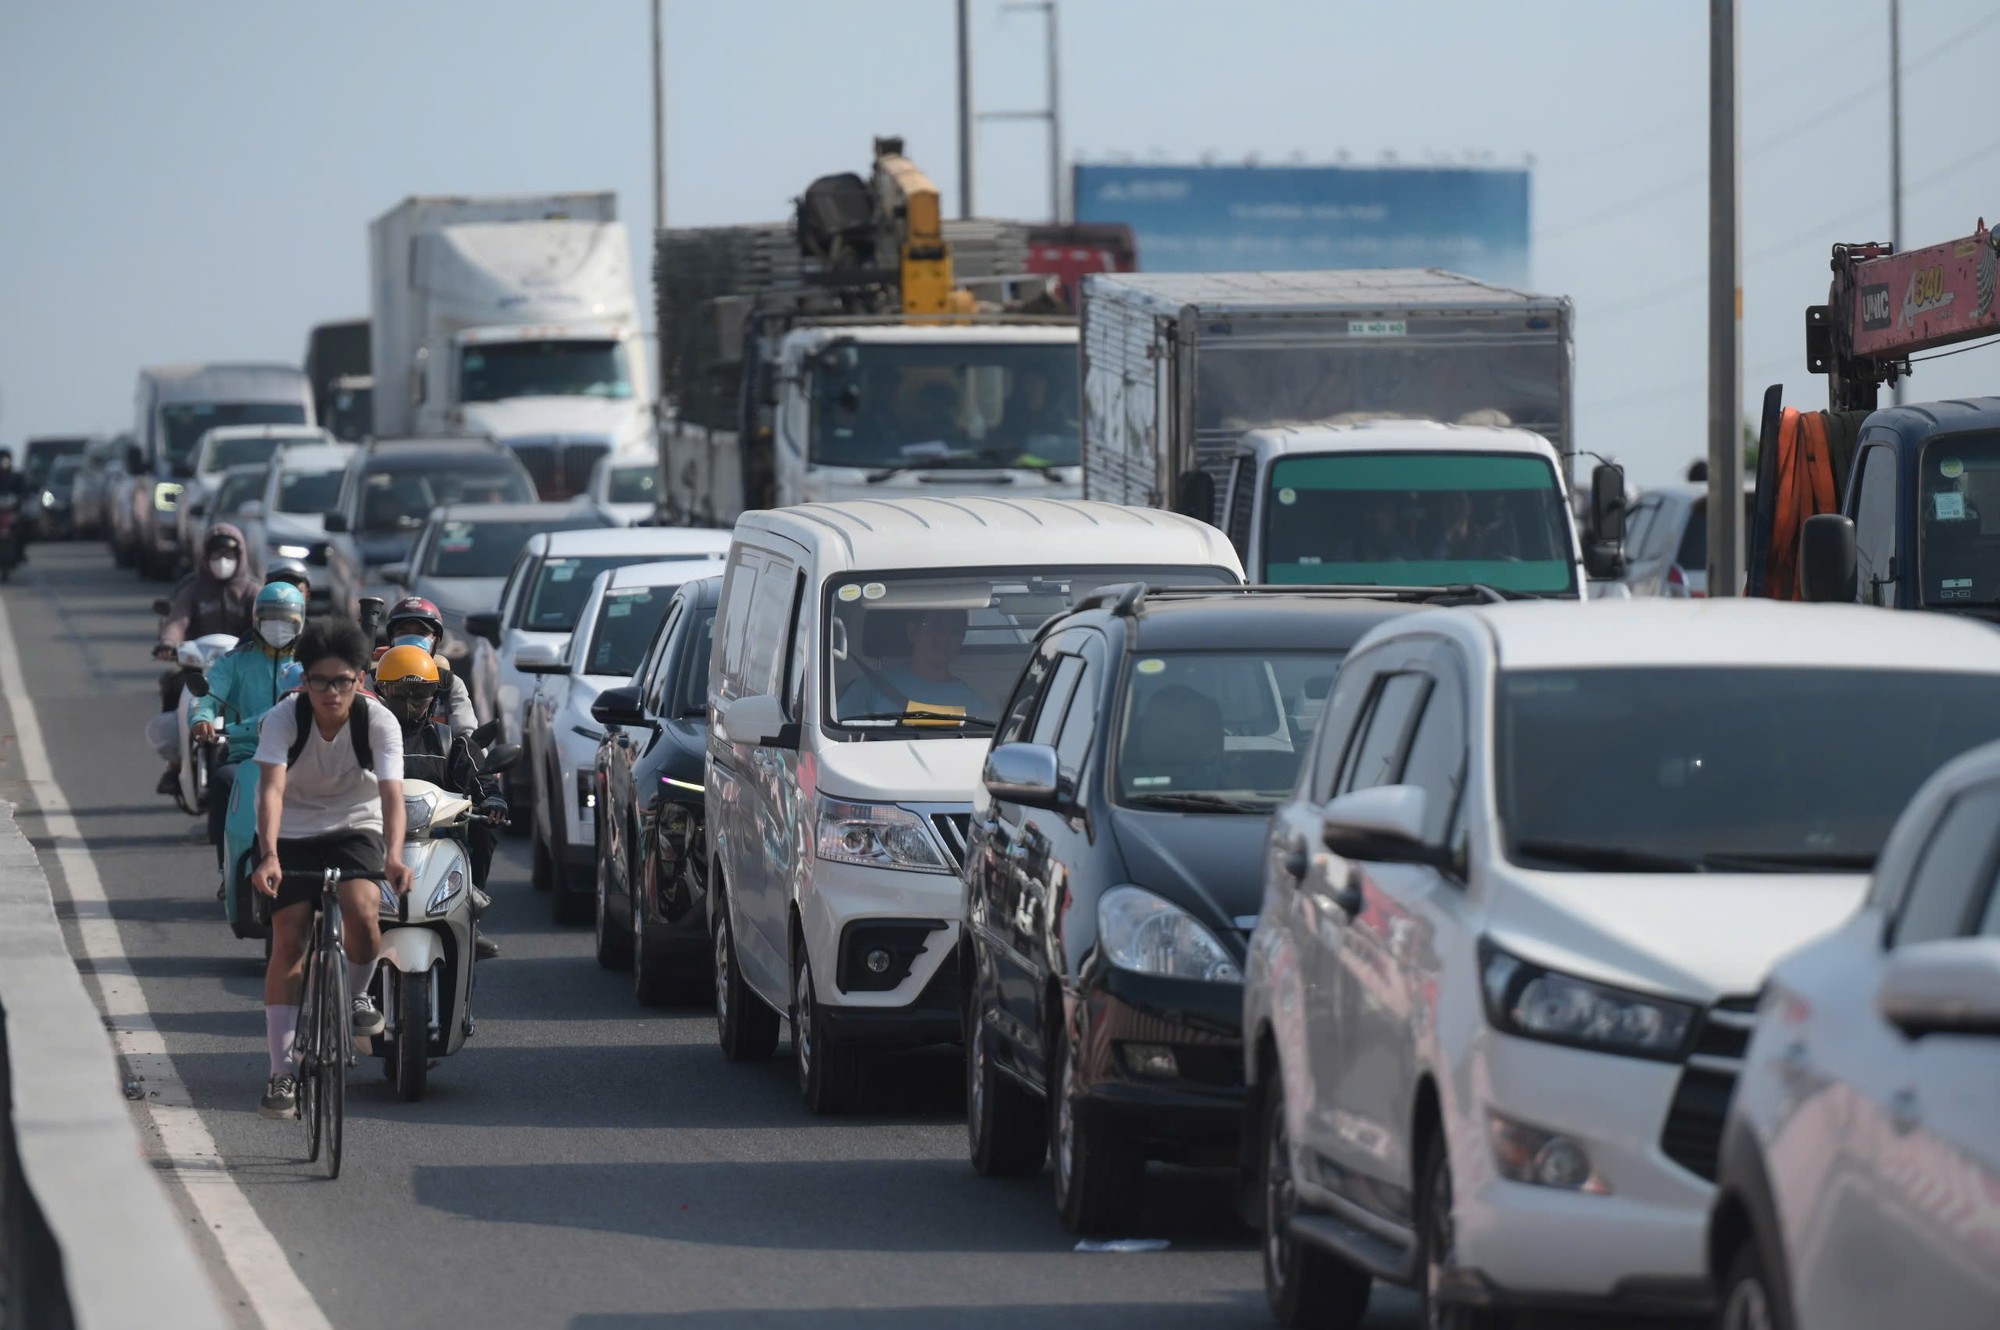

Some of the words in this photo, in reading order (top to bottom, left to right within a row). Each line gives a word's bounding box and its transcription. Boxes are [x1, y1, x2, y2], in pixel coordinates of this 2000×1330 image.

[1862, 290, 1889, 322] UNIC
[1351, 324, 1363, 332] XE
[1368, 322, 1386, 333] NỘI
[1389, 322, 1404, 333] BỘ
